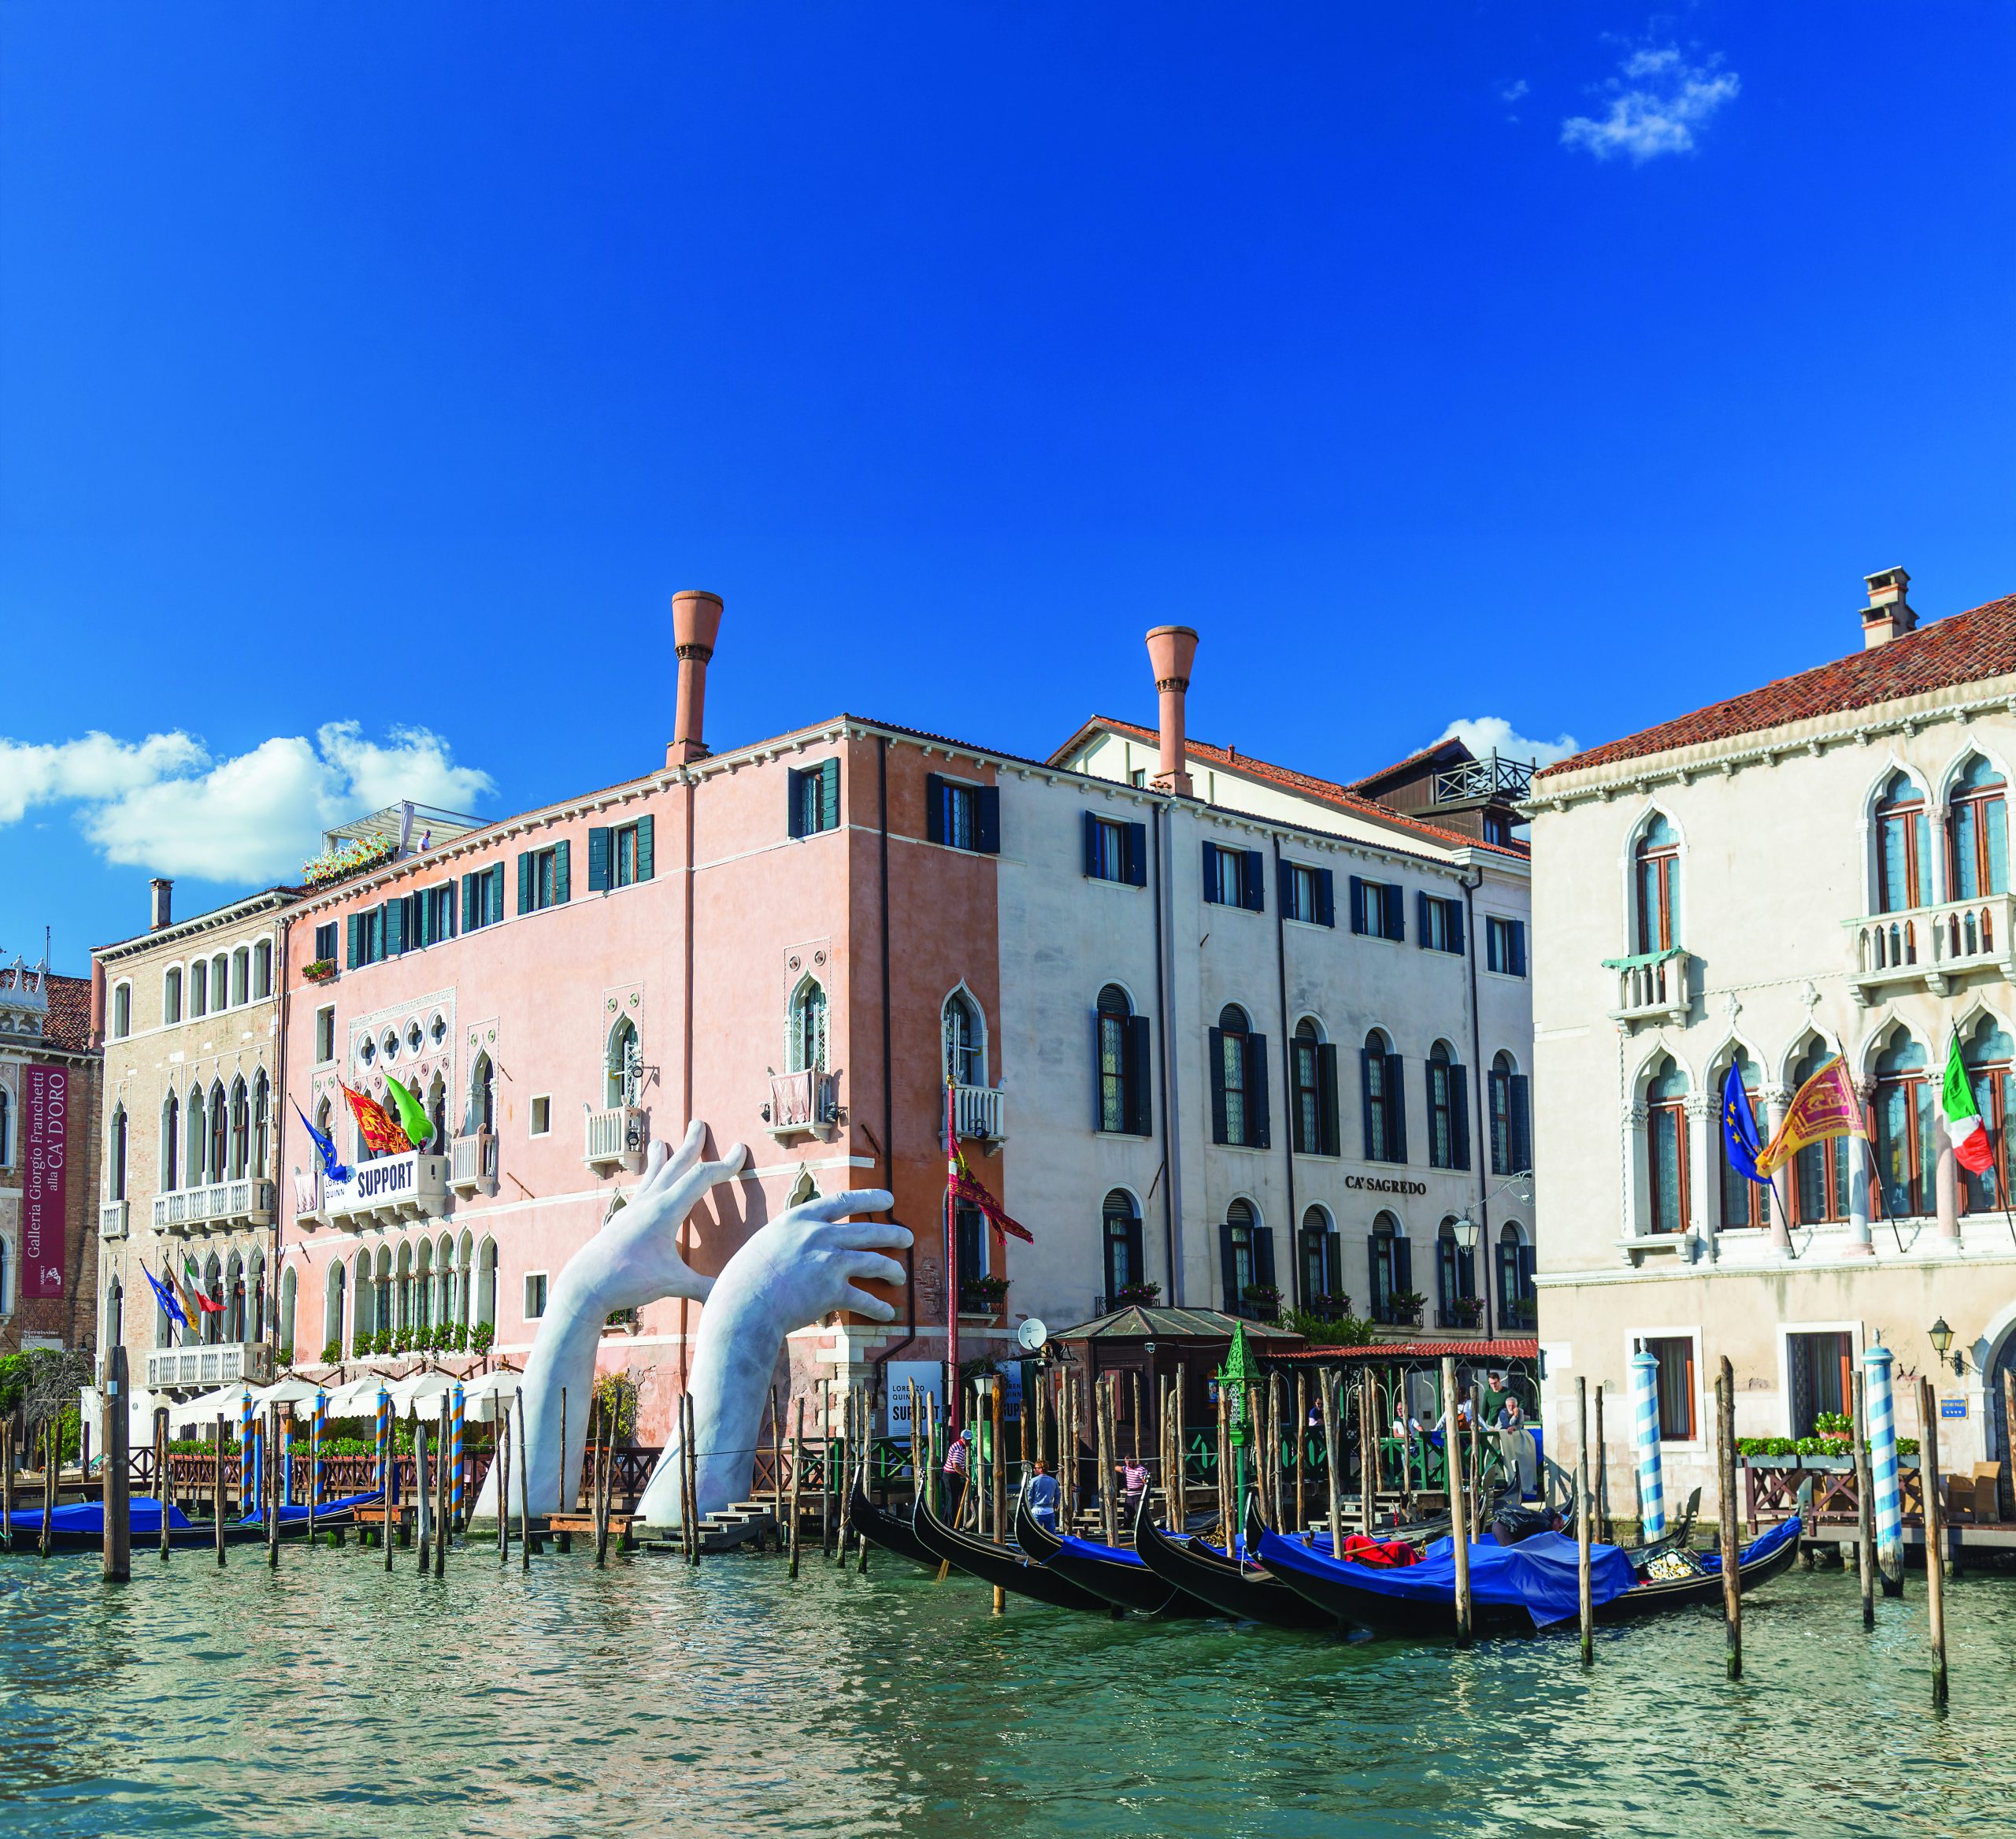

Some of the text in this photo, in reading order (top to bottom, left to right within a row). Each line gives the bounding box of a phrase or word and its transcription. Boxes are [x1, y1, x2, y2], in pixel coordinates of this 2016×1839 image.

[47, 1073, 65, 1191] alla CA' D'ORO
[28, 1072, 46, 1258] Galleria Giorgio Franchetti
[325, 1174, 352, 1188] LOREO
[358, 1161, 413, 1198] SUPPORT
[1344, 1175, 1427, 1195] CA' SAGREDO
[325, 1188, 345, 1199] QUINN
[892, 1405, 940, 1421] SUPOT
